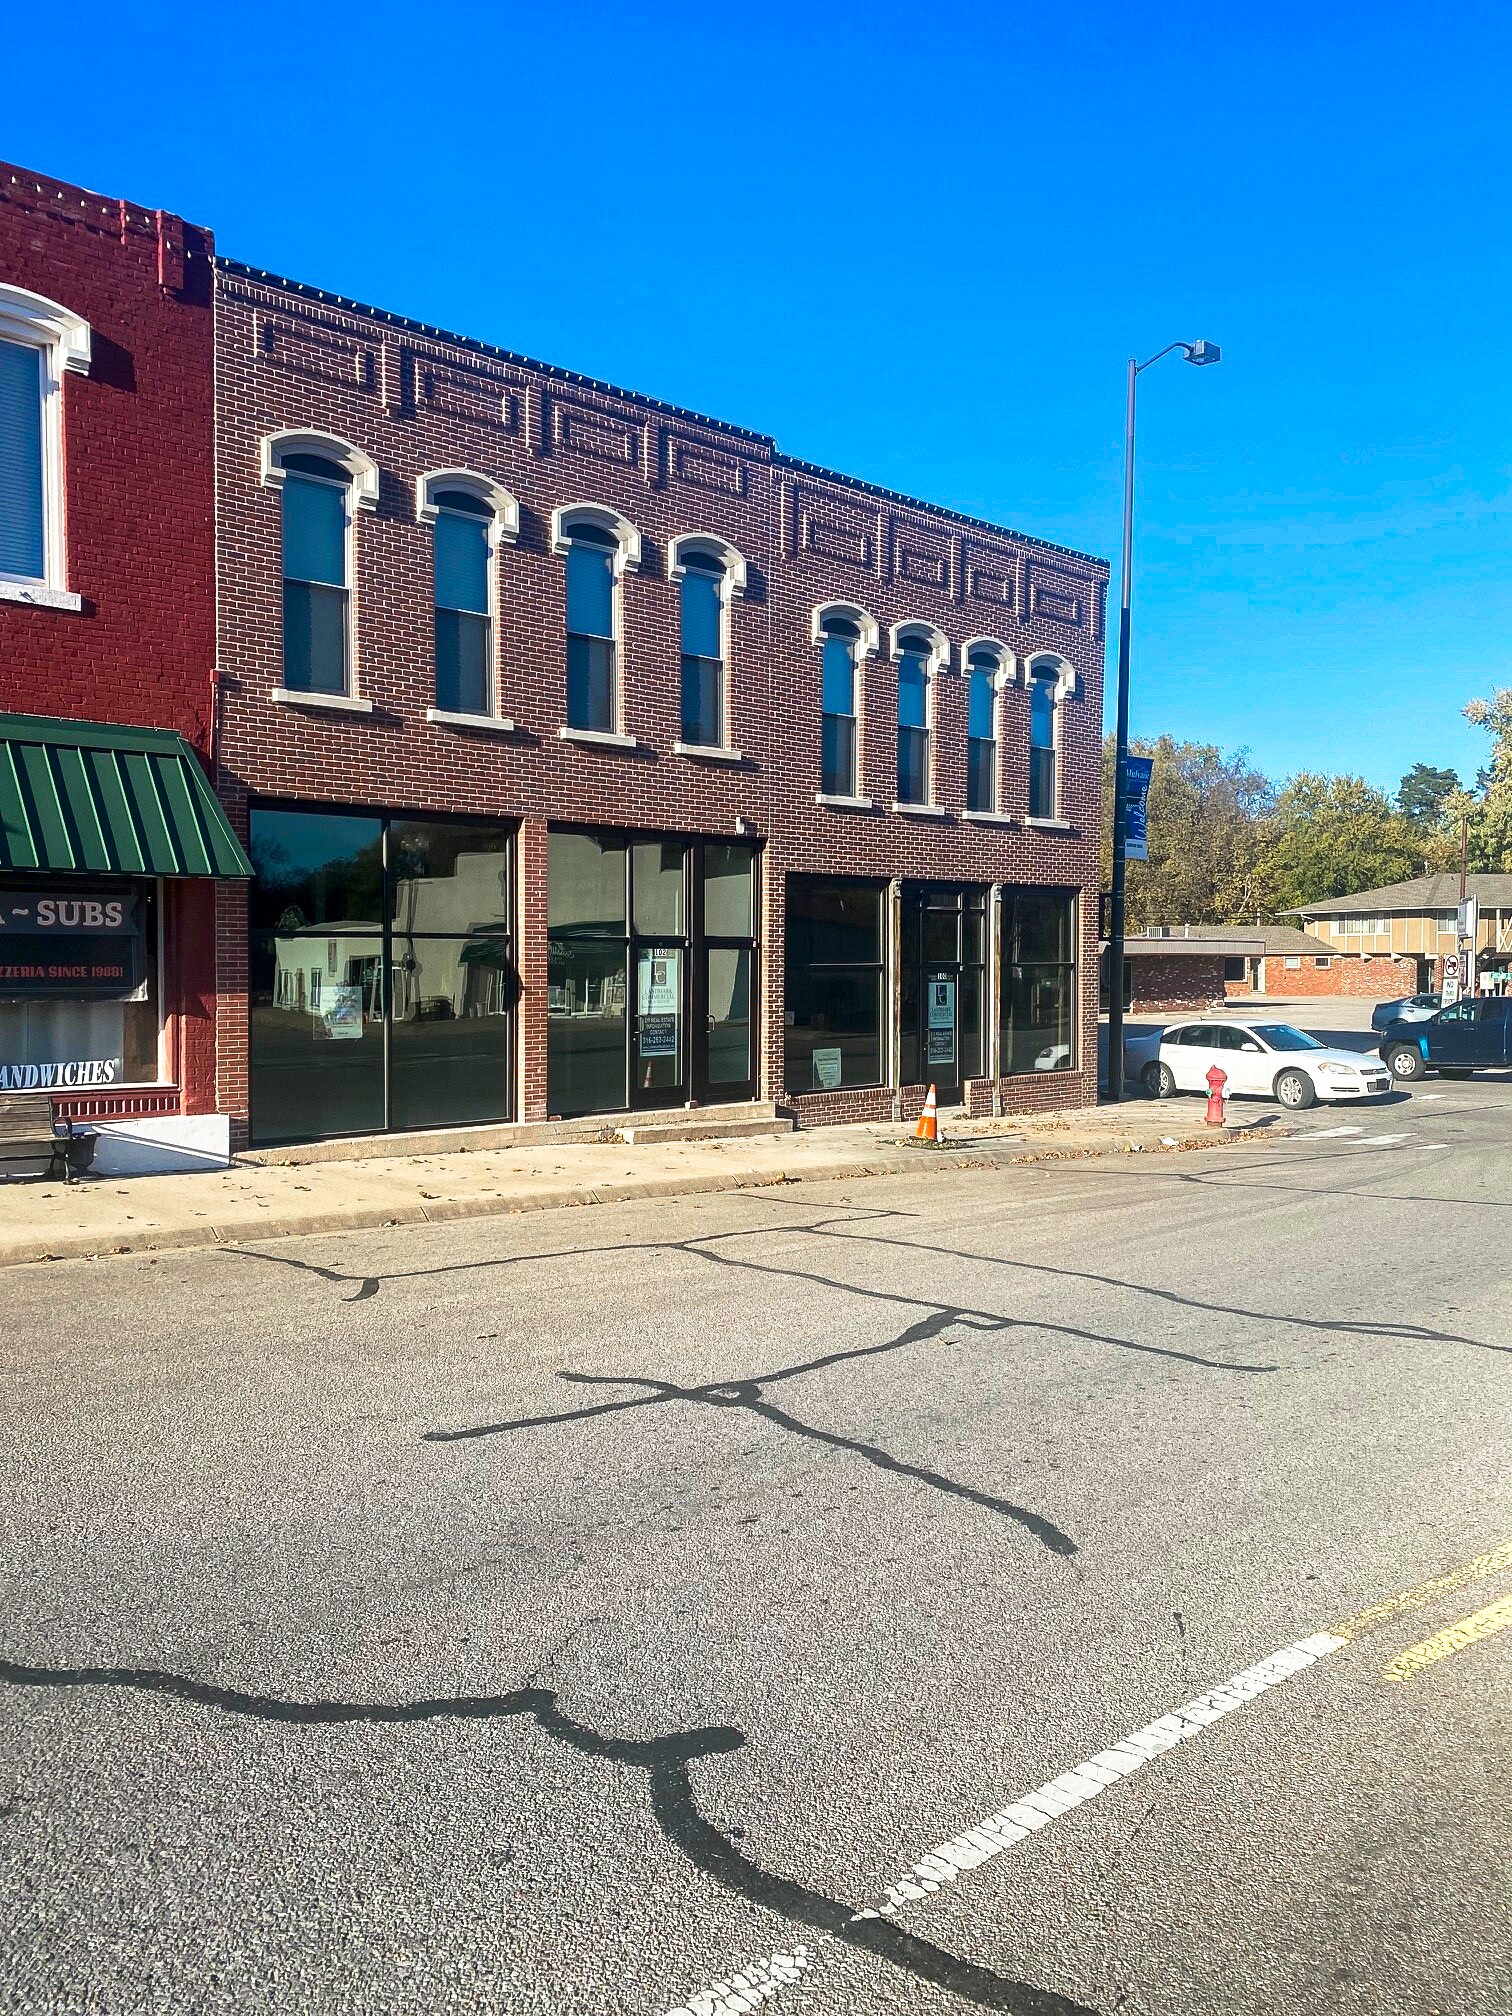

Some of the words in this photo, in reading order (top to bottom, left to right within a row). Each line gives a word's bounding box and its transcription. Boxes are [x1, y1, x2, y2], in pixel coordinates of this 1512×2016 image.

[1134, 784, 1148, 840] Welcome
[36, 900, 123, 927] SUBS
[48, 966, 87, 978] SINCE
[91, 966, 124, 978] 1988!
[0, 1059, 115, 1089] ANDWICHES
